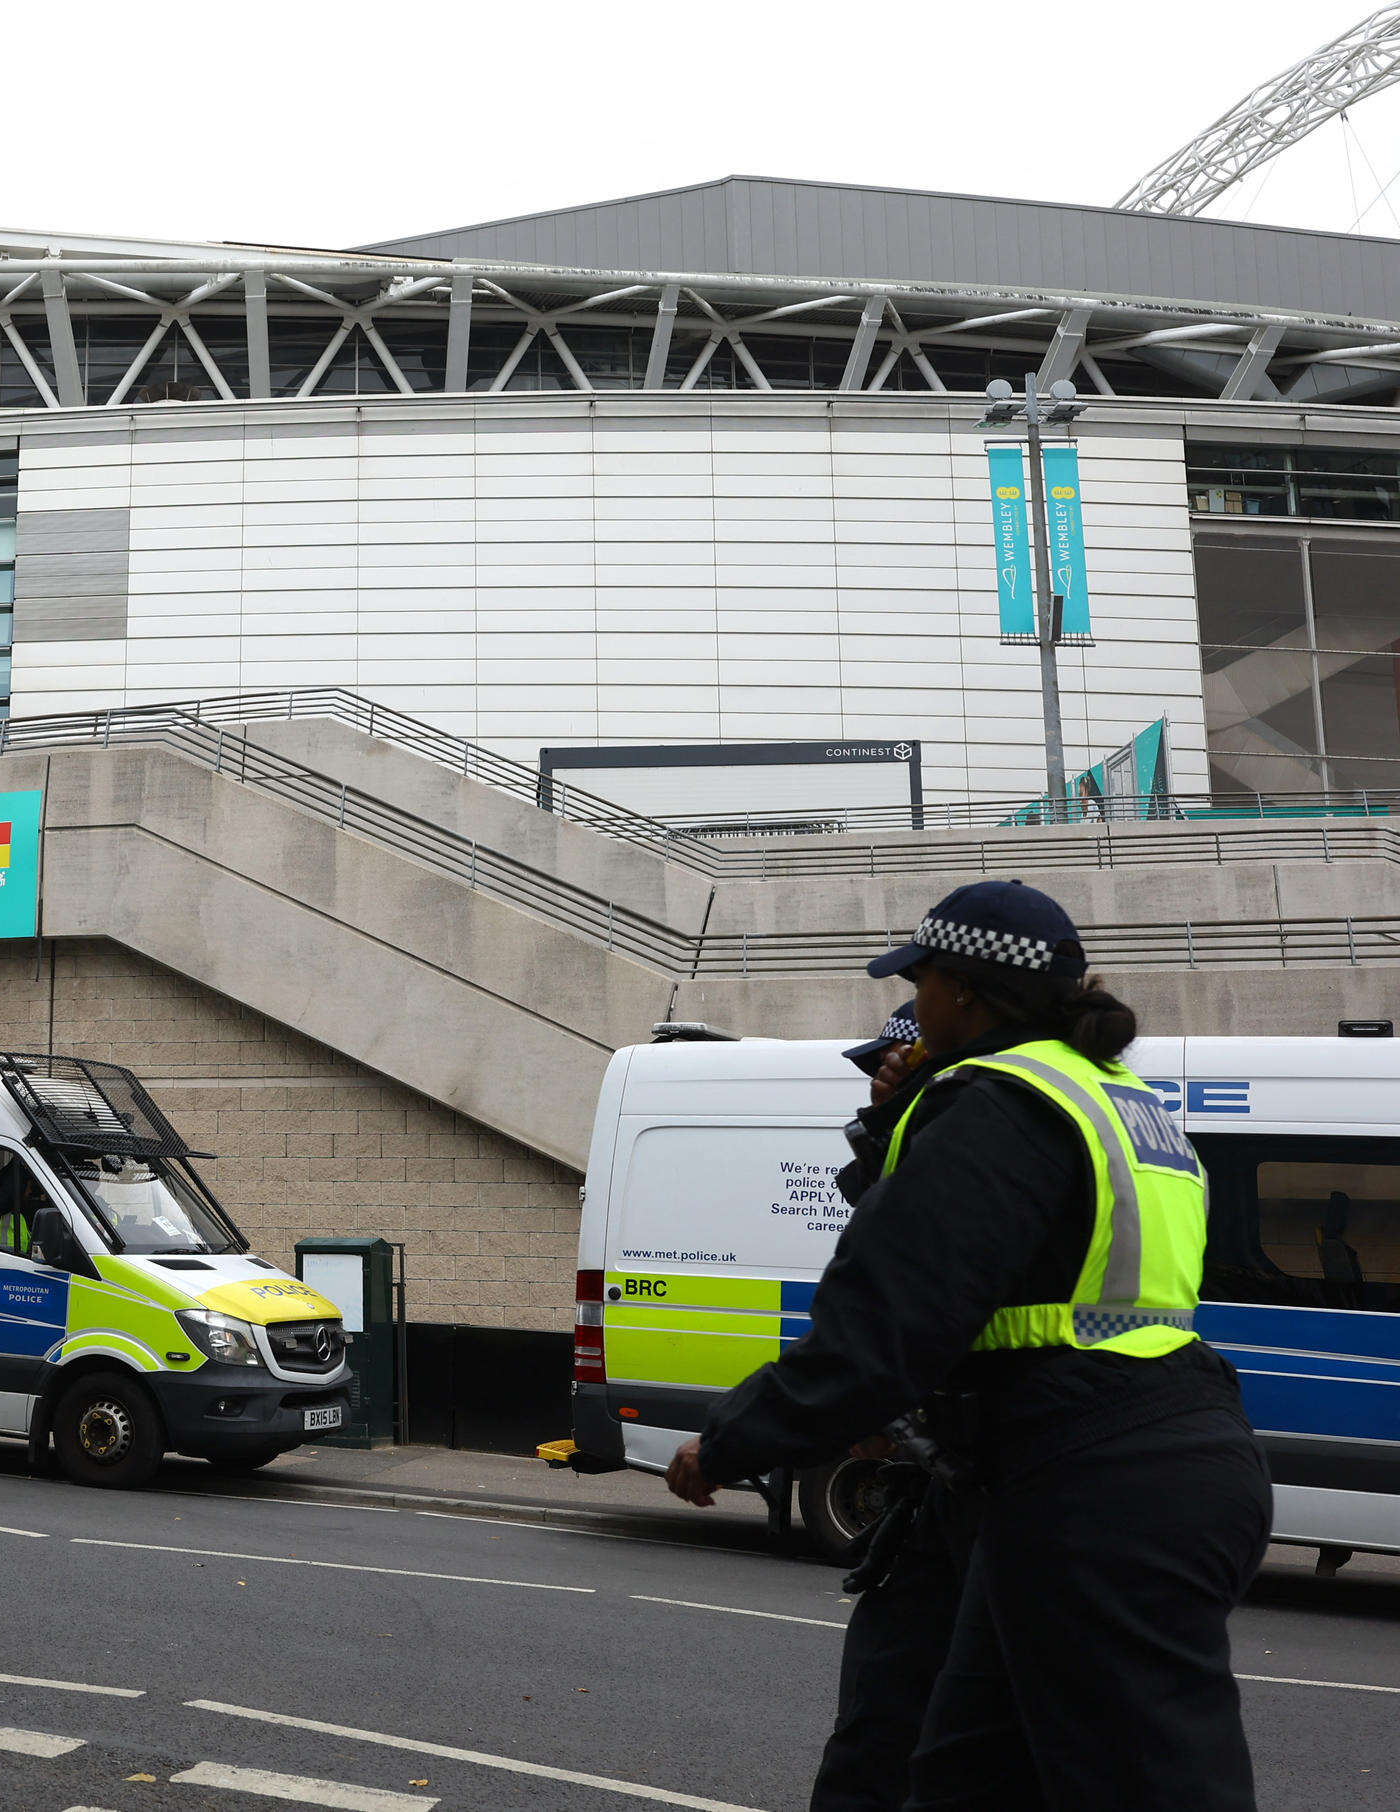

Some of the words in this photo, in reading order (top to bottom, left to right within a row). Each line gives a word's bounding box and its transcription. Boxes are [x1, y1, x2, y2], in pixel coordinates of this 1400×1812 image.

[1000, 501, 1016, 562] WEMBLEY
[1055, 501, 1072, 562] WEMBLEY
[825, 747, 891, 757] CONTINEST
[780, 1161, 820, 1175] We’re
[785, 1176, 825, 1189] police
[789, 1190, 835, 1203] APPLY
[771, 1202, 817, 1217] Search
[823, 1205, 849, 1219] Met
[622, 1249, 737, 1263] www.met.police.uk
[2, 1284, 50, 1295] METROPOLITAN
[250, 1282, 319, 1300] POLICE
[625, 1278, 668, 1297] BRC
[8, 1293, 43, 1304] POLICE
[309, 1410, 328, 1426] BX15
